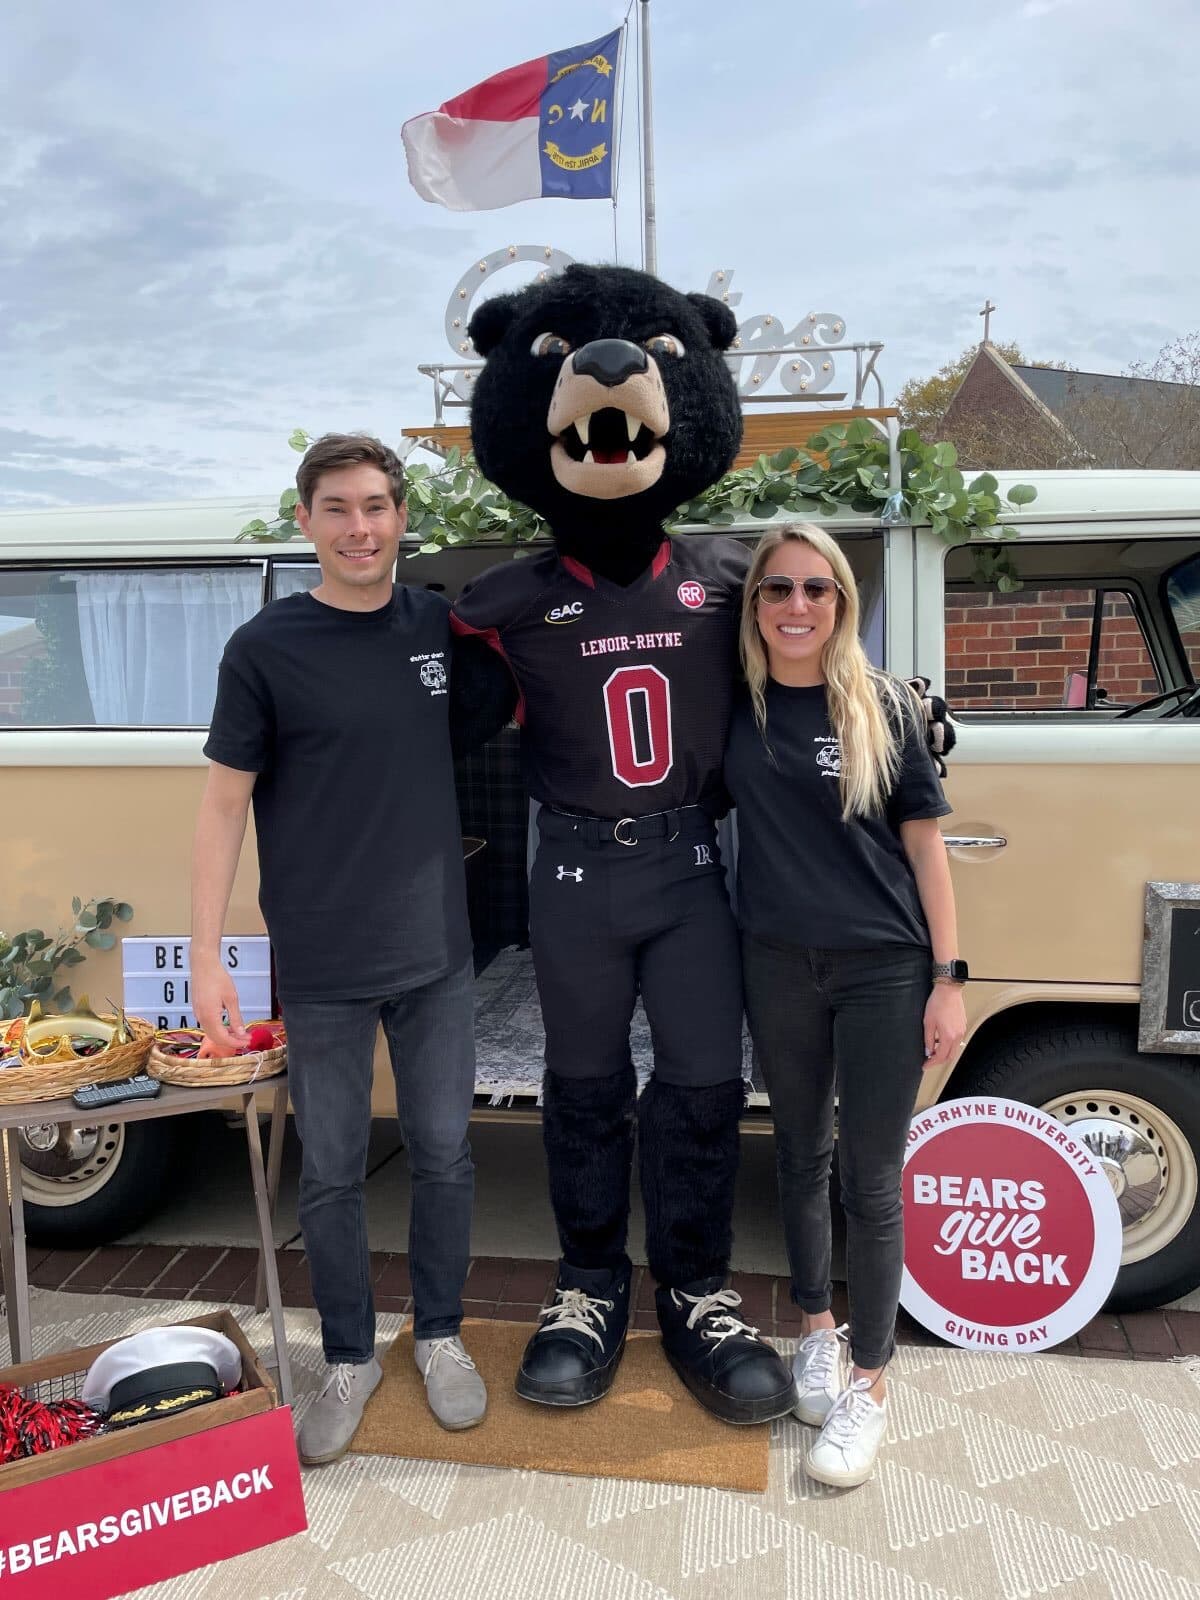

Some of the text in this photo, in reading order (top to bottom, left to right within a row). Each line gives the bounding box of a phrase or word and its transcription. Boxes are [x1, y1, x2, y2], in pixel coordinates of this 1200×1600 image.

[680, 586, 701, 602] RR
[550, 601, 584, 620] SAC
[580, 632, 683, 657] LENOIR-RHYNE
[603, 664, 673, 788] 0
[155, 945, 238, 968] BES
[164, 980, 189, 1003] GI
[157, 1016, 200, 1031] BA
[904, 1104, 1097, 1177] OIR-RHYNE UNIVERSITY
[913, 1174, 1046, 1211] BEARS
[933, 1210, 1041, 1256] give
[961, 1249, 1071, 1287] BACK
[945, 1321, 1048, 1346] GIVING DAY
